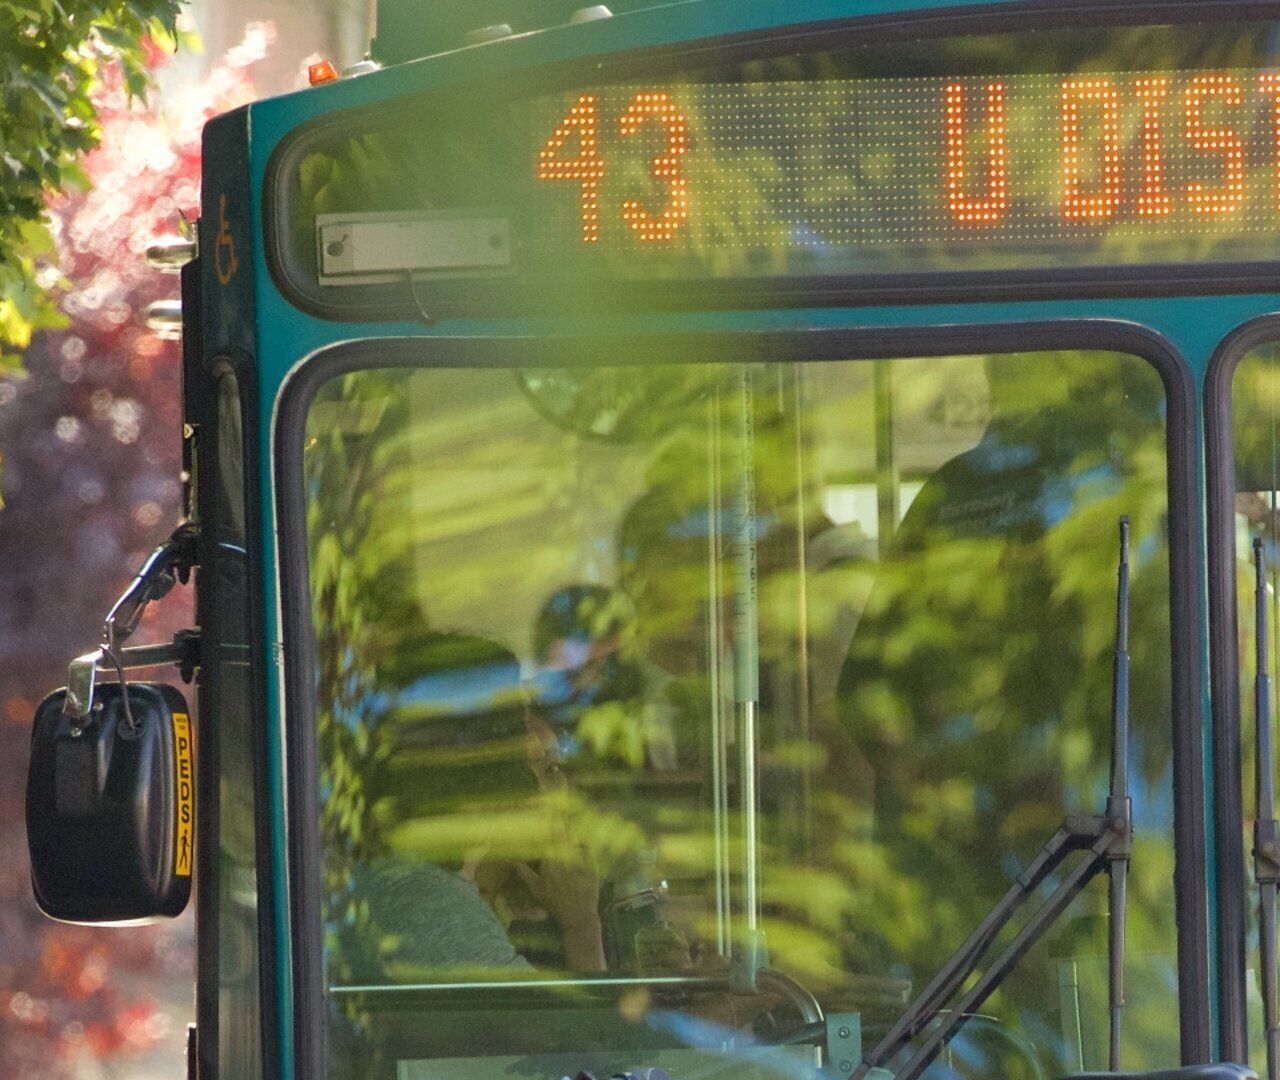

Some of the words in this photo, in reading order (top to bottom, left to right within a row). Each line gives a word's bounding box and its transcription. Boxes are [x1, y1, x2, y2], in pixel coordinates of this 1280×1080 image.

[535, 92, 688, 243] 43
[945, 82, 1006, 222] U
[178, 737, 191, 824] PEDS
